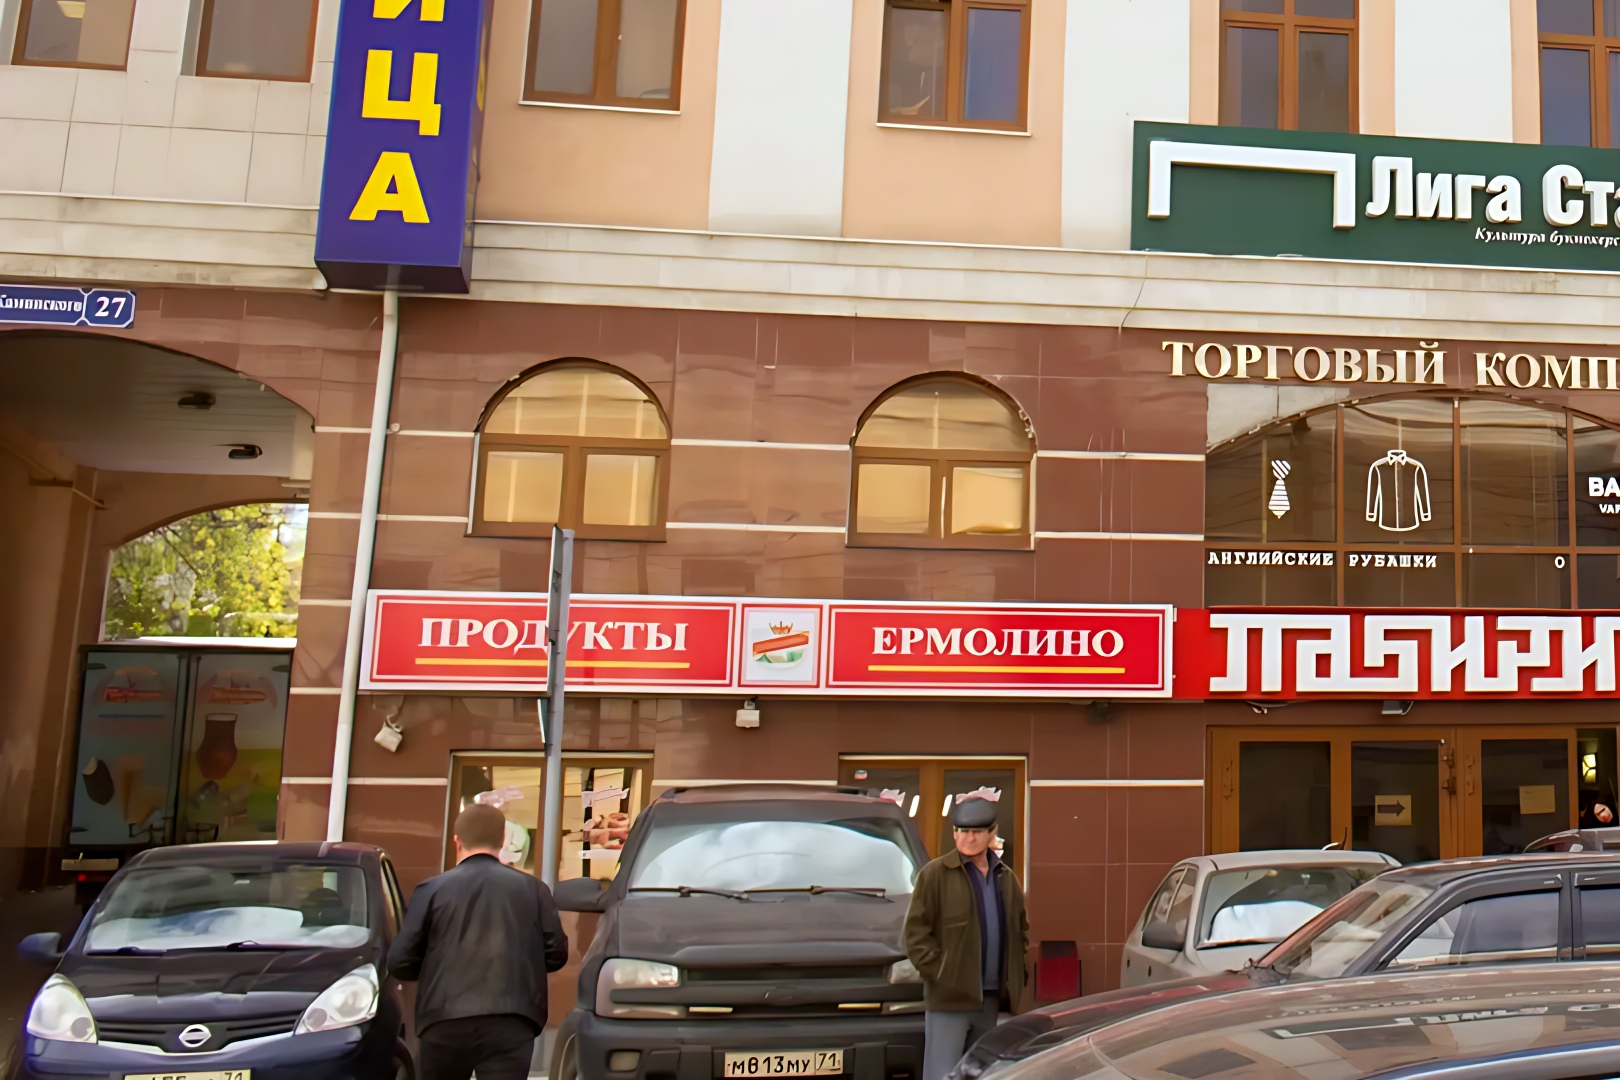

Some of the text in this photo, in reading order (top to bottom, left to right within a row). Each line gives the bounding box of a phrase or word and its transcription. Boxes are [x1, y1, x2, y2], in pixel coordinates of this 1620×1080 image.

[1364, 155, 1523, 224] Лига
[94, 296, 127, 319] 27
[1161, 340, 1448, 386] ТОРГОВЫЙ
[1207, 551, 1438, 569] АНГЛИЙСКИЕ РУБАШКИ
[871, 626, 1125, 658] ЕРМОЛИНО
